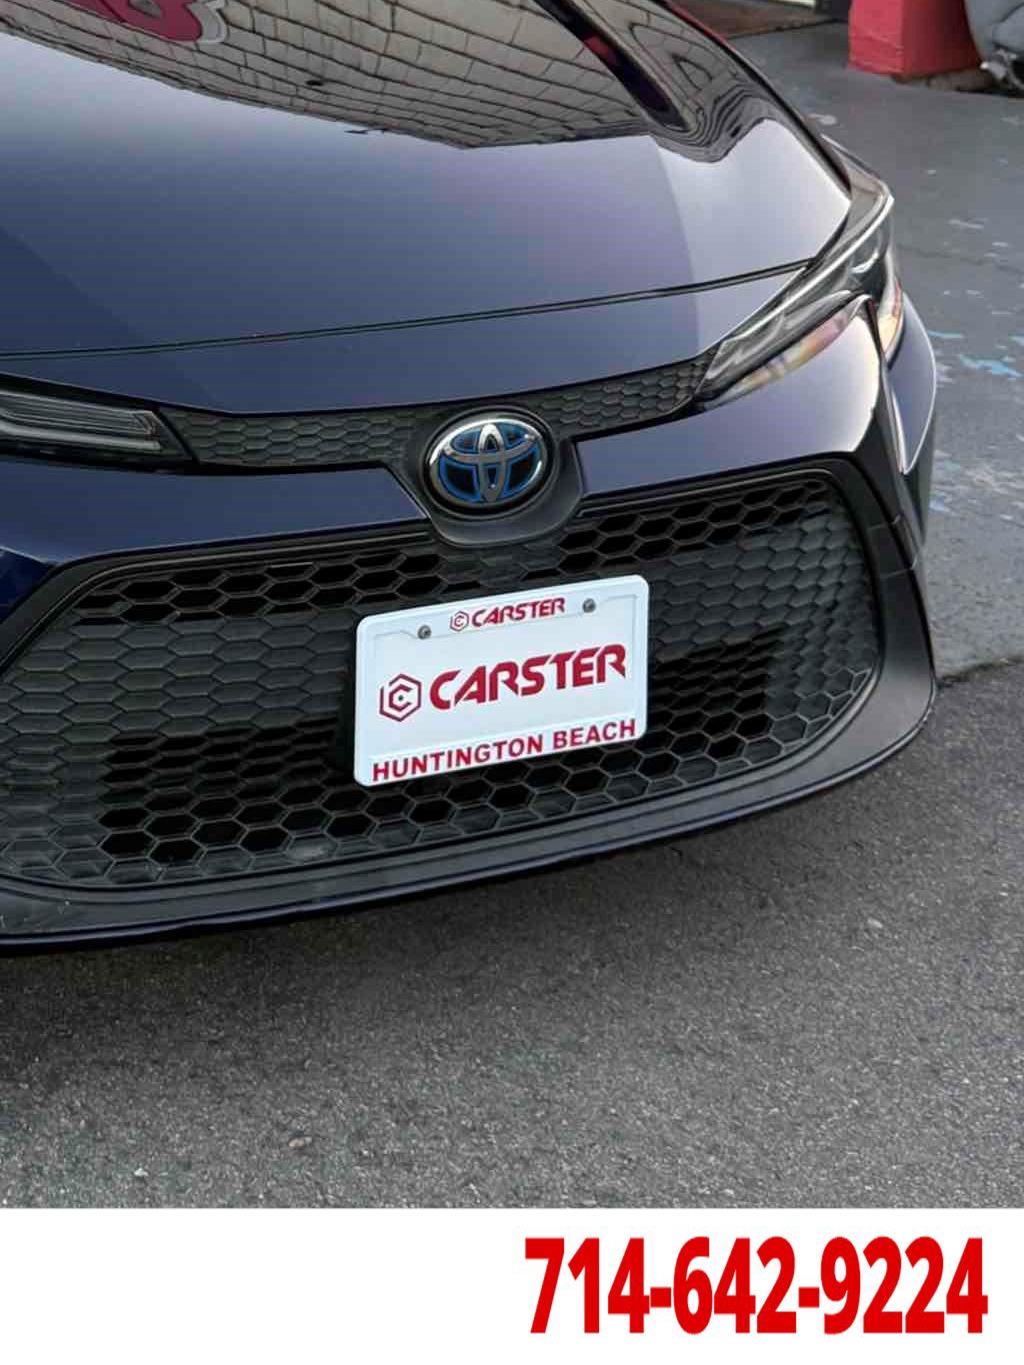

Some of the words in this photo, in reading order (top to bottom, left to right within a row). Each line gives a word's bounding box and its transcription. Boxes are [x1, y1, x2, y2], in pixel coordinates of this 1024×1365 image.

[471, 597, 566, 628] CARSTER
[429, 643, 627, 711] CARSTER
[372, 735, 544, 784] HUNTINGTON
[553, 718, 637, 749] BEACH
